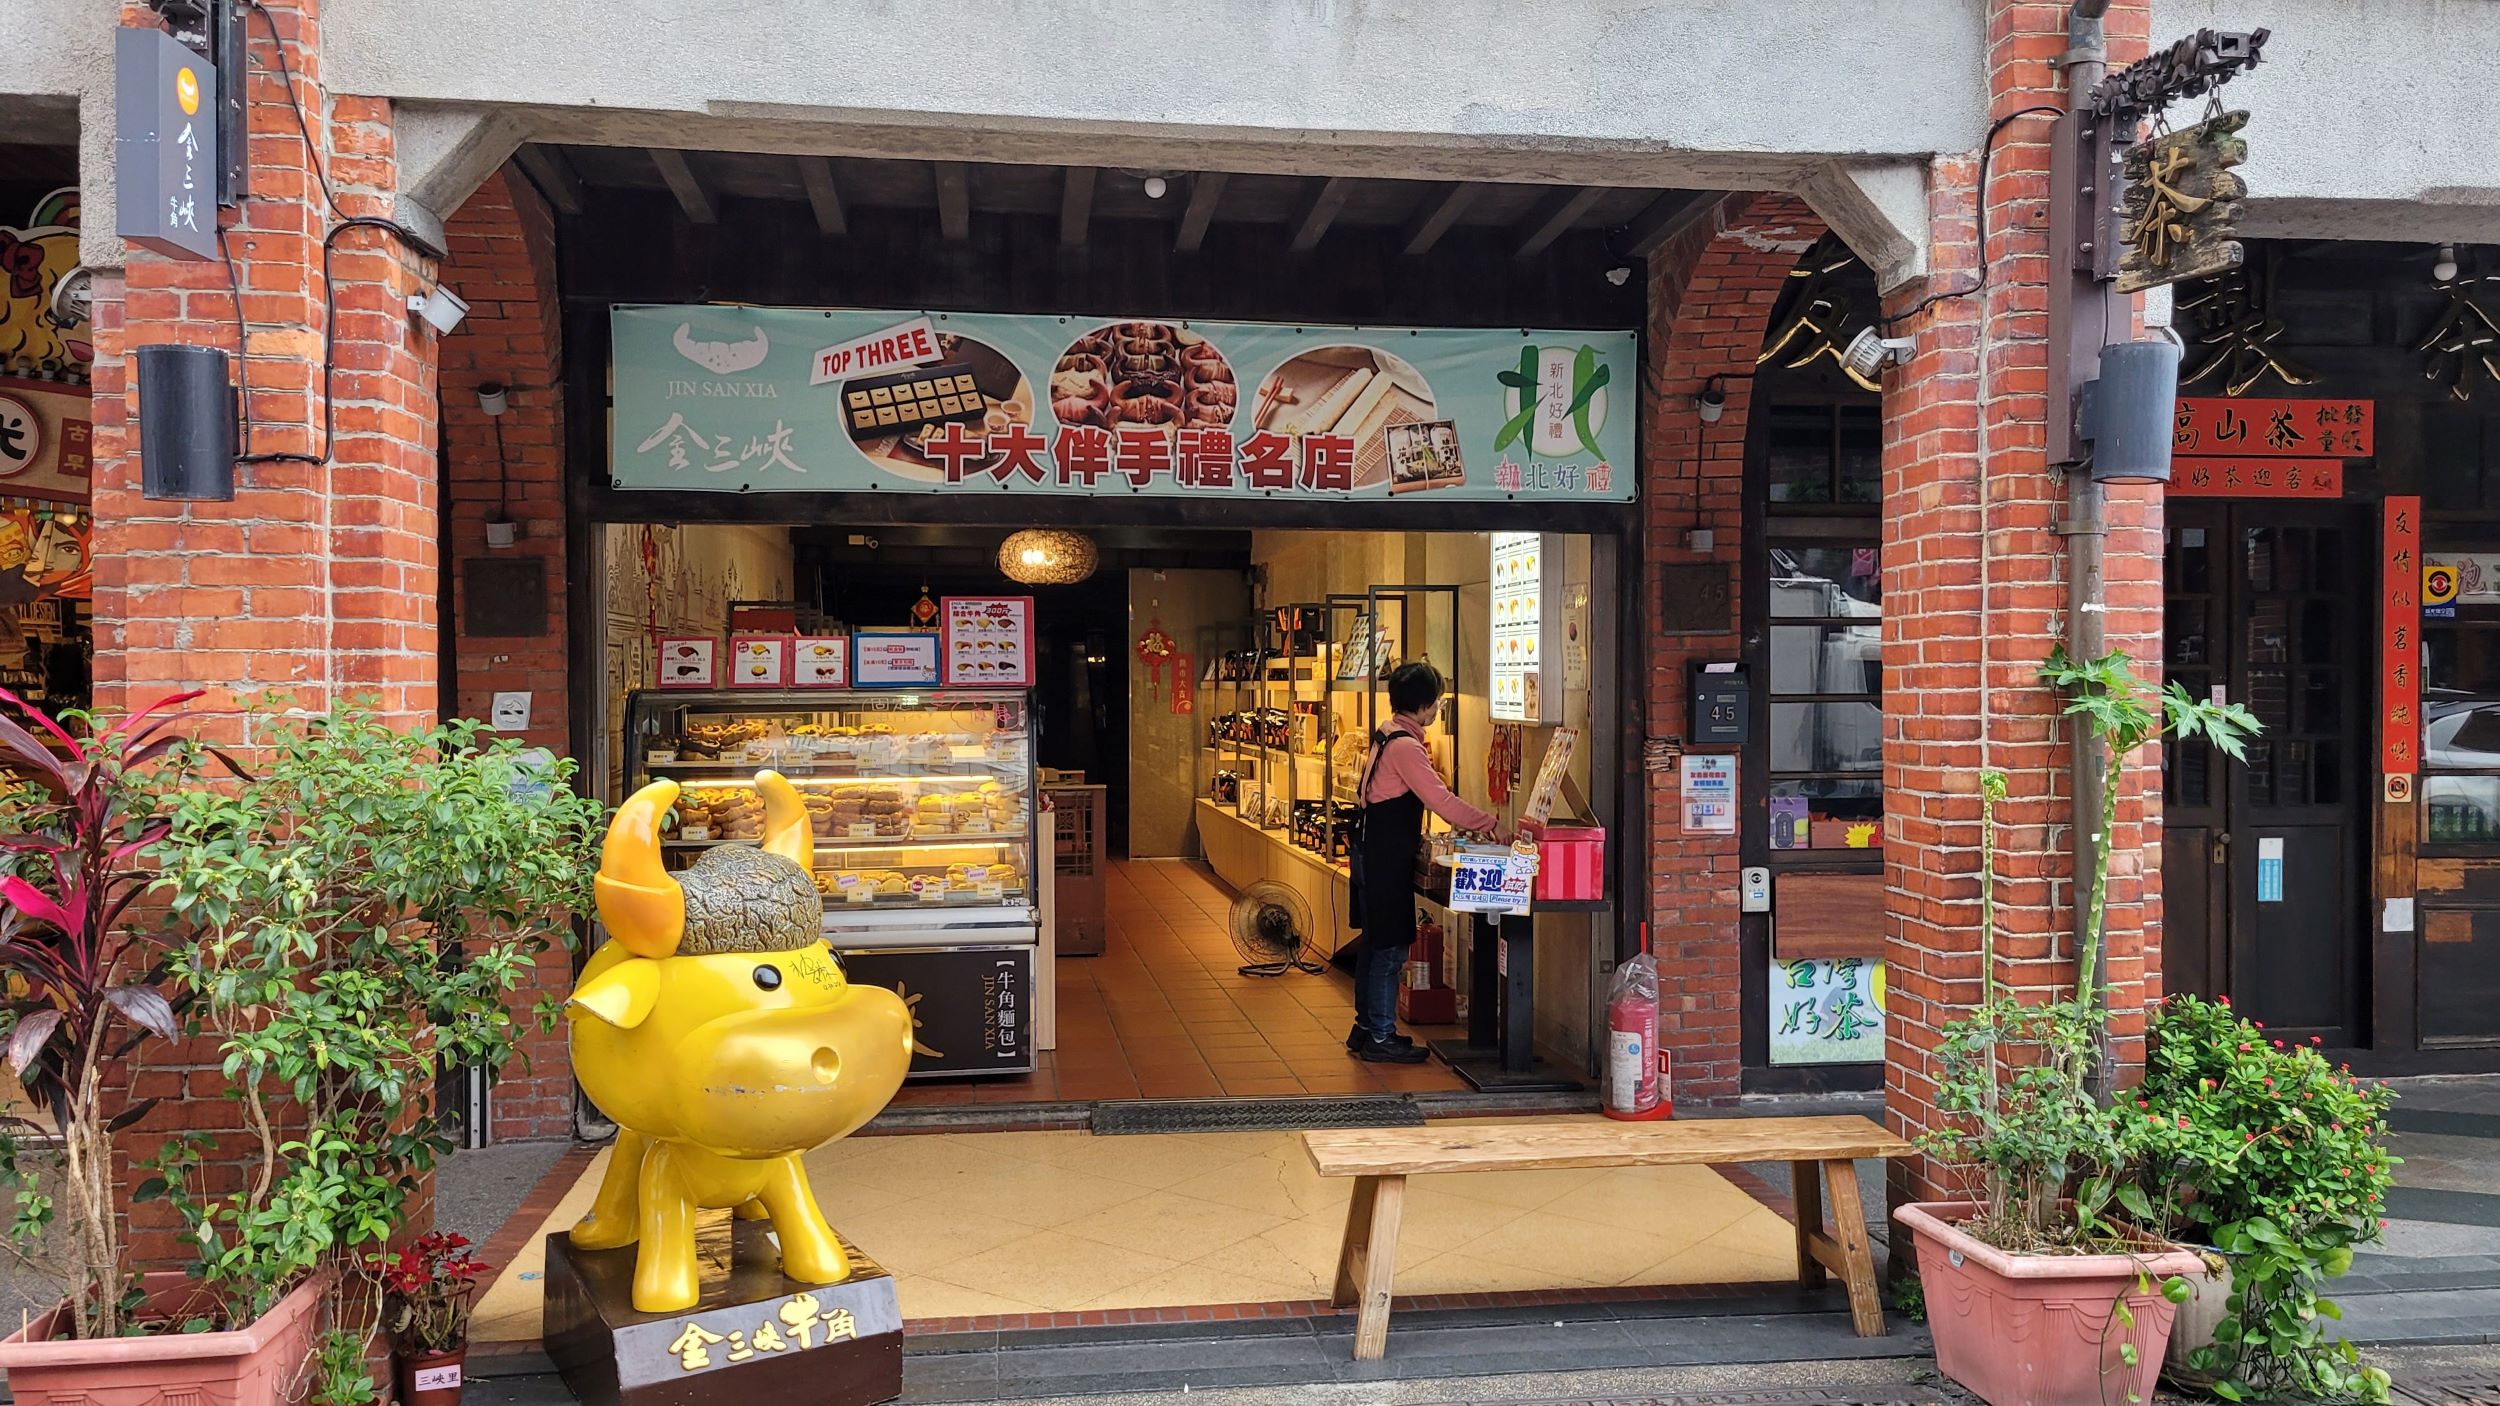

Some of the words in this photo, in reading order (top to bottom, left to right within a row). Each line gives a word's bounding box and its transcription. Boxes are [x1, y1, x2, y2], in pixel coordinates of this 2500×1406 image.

[169, 195, 178, 228] 牛角
[822, 348, 851, 378] TOP
[855, 327, 933, 369] THREE
[666, 380, 698, 399] JIN
[702, 381, 740, 399] SAN
[745, 382, 777, 399] XIA
[1549, 363, 1564, 439] 新北好禮
[637, 411, 807, 473] 金三峽
[924, 422, 1356, 492] 十大伴手禮名店
[1711, 705, 1736, 721] 45
[1455, 868, 1501, 892] 歡迎
[1512, 897, 1521, 905] try
[982, 974, 995, 997] JIN
[984, 999, 996, 1026] SAN
[1778, 992, 1879, 1041] 好茶
[984, 1028, 996, 1051] XIA
[668, 1293, 859, 1371] 金三峽牛角
[418, 1372, 460, 1386] 三峽里
